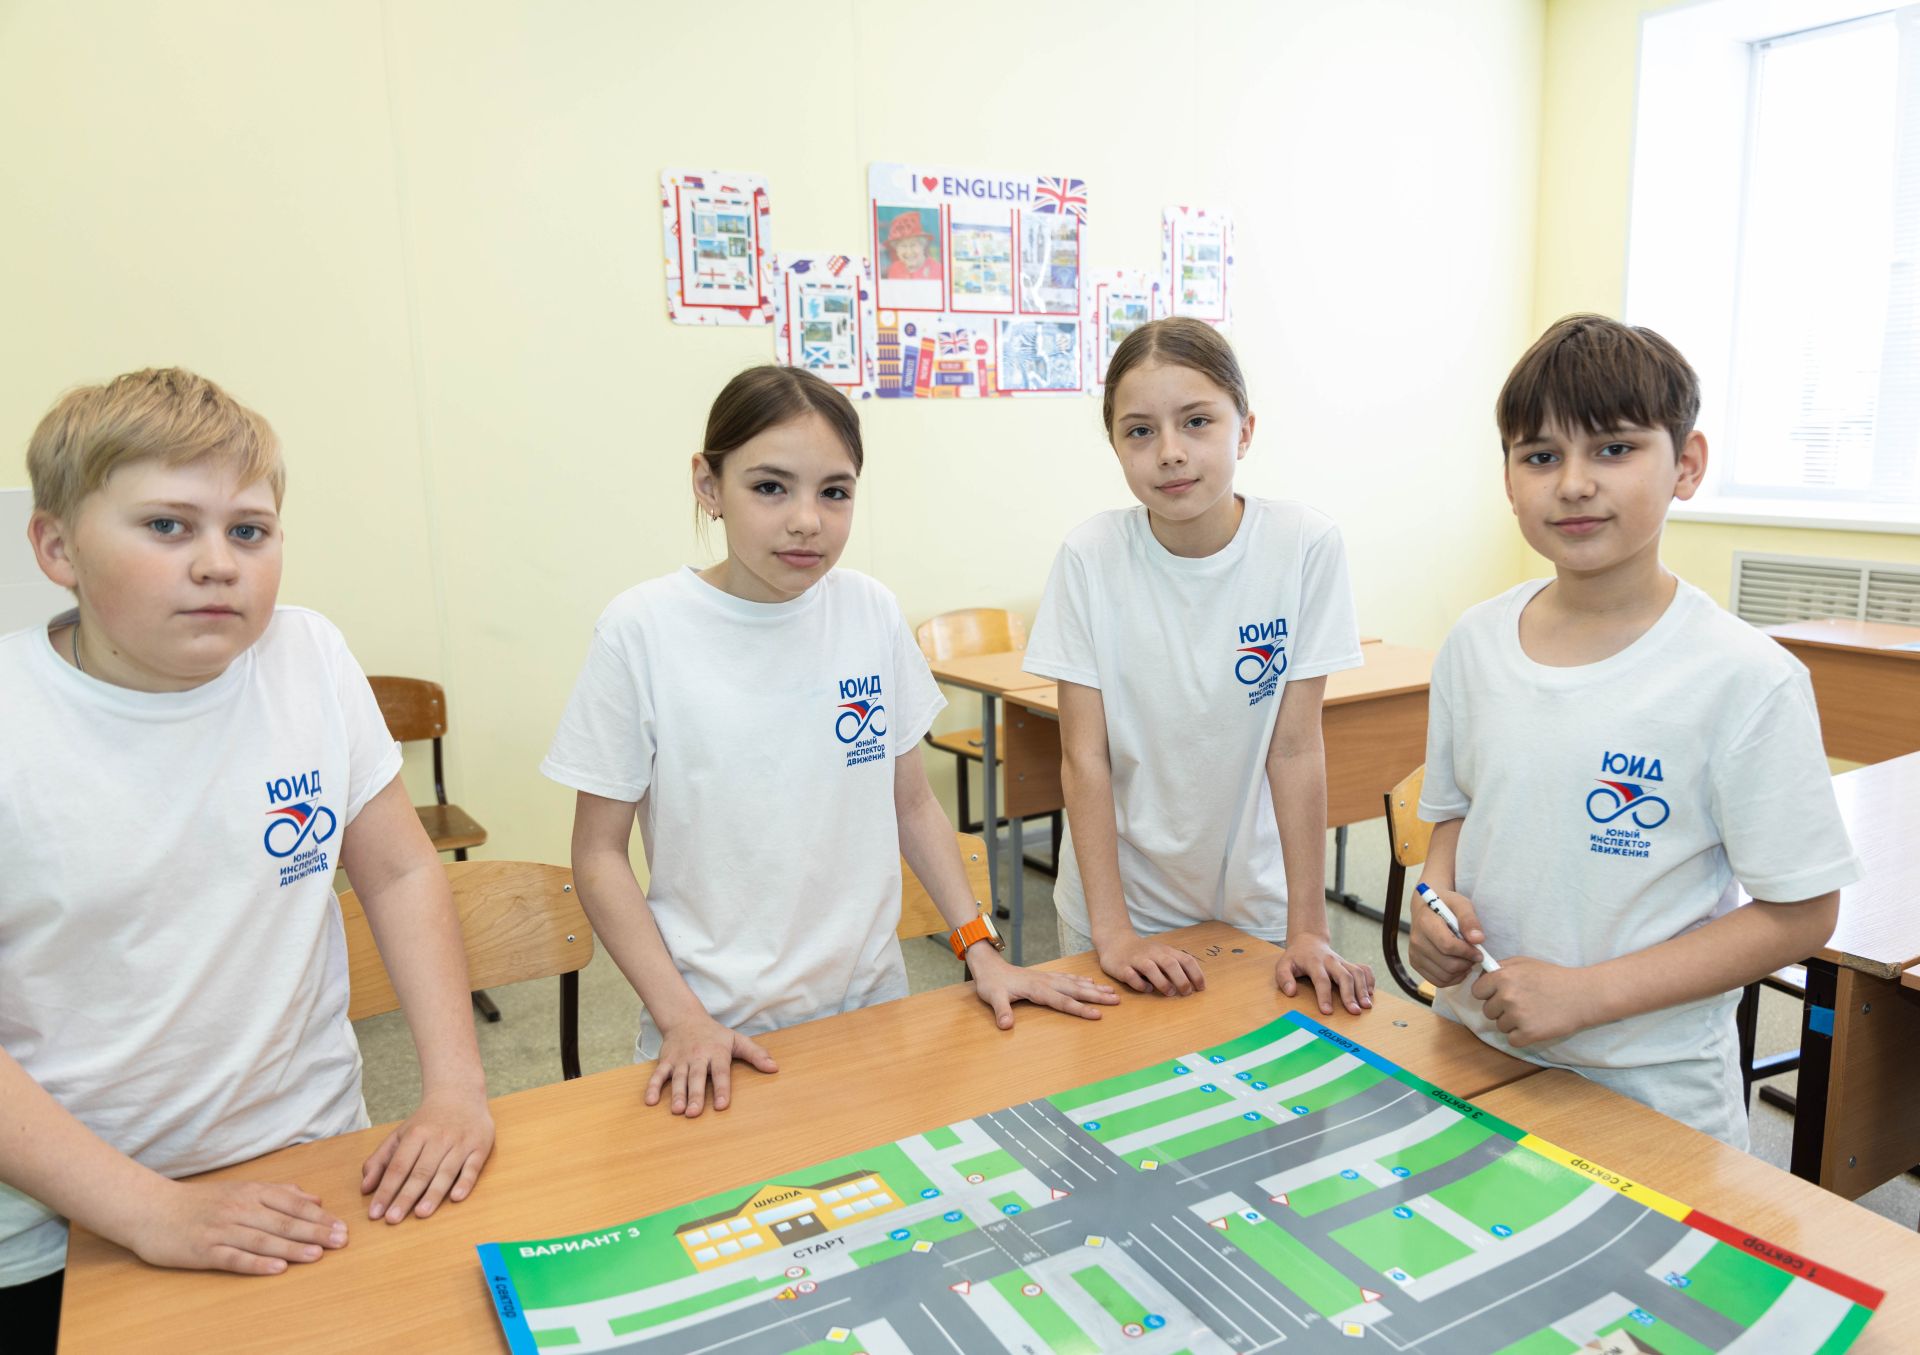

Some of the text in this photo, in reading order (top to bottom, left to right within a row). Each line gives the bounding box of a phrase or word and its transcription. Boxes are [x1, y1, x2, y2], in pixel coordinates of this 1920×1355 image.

[911, 174, 1030, 201] I ENGLISH
[1239, 618, 1288, 643] ЮИД
[838, 674, 882, 699] ЮИД
[1601, 751, 1664, 782] ЮИД
[266, 769, 322, 804] ЮИД
[1590, 833, 1651, 848] ИНСПЕКТОР
[1605, 828, 1640, 839] ЮНЫЙ
[1590, 843, 1649, 858] ДВИЖЕНИЯ
[1318, 1028, 1354, 1049] сектор
[1432, 1089, 1484, 1120] 3 сектор
[1571, 1158, 1633, 1193] 2 сектор
[753, 1189, 802, 1209] ШКОЛА
[519, 1227, 641, 1259] ВАРИАНТ 3
[792, 1236, 846, 1259] СТАРТ
[1743, 1237, 1817, 1278] 1 сектор
